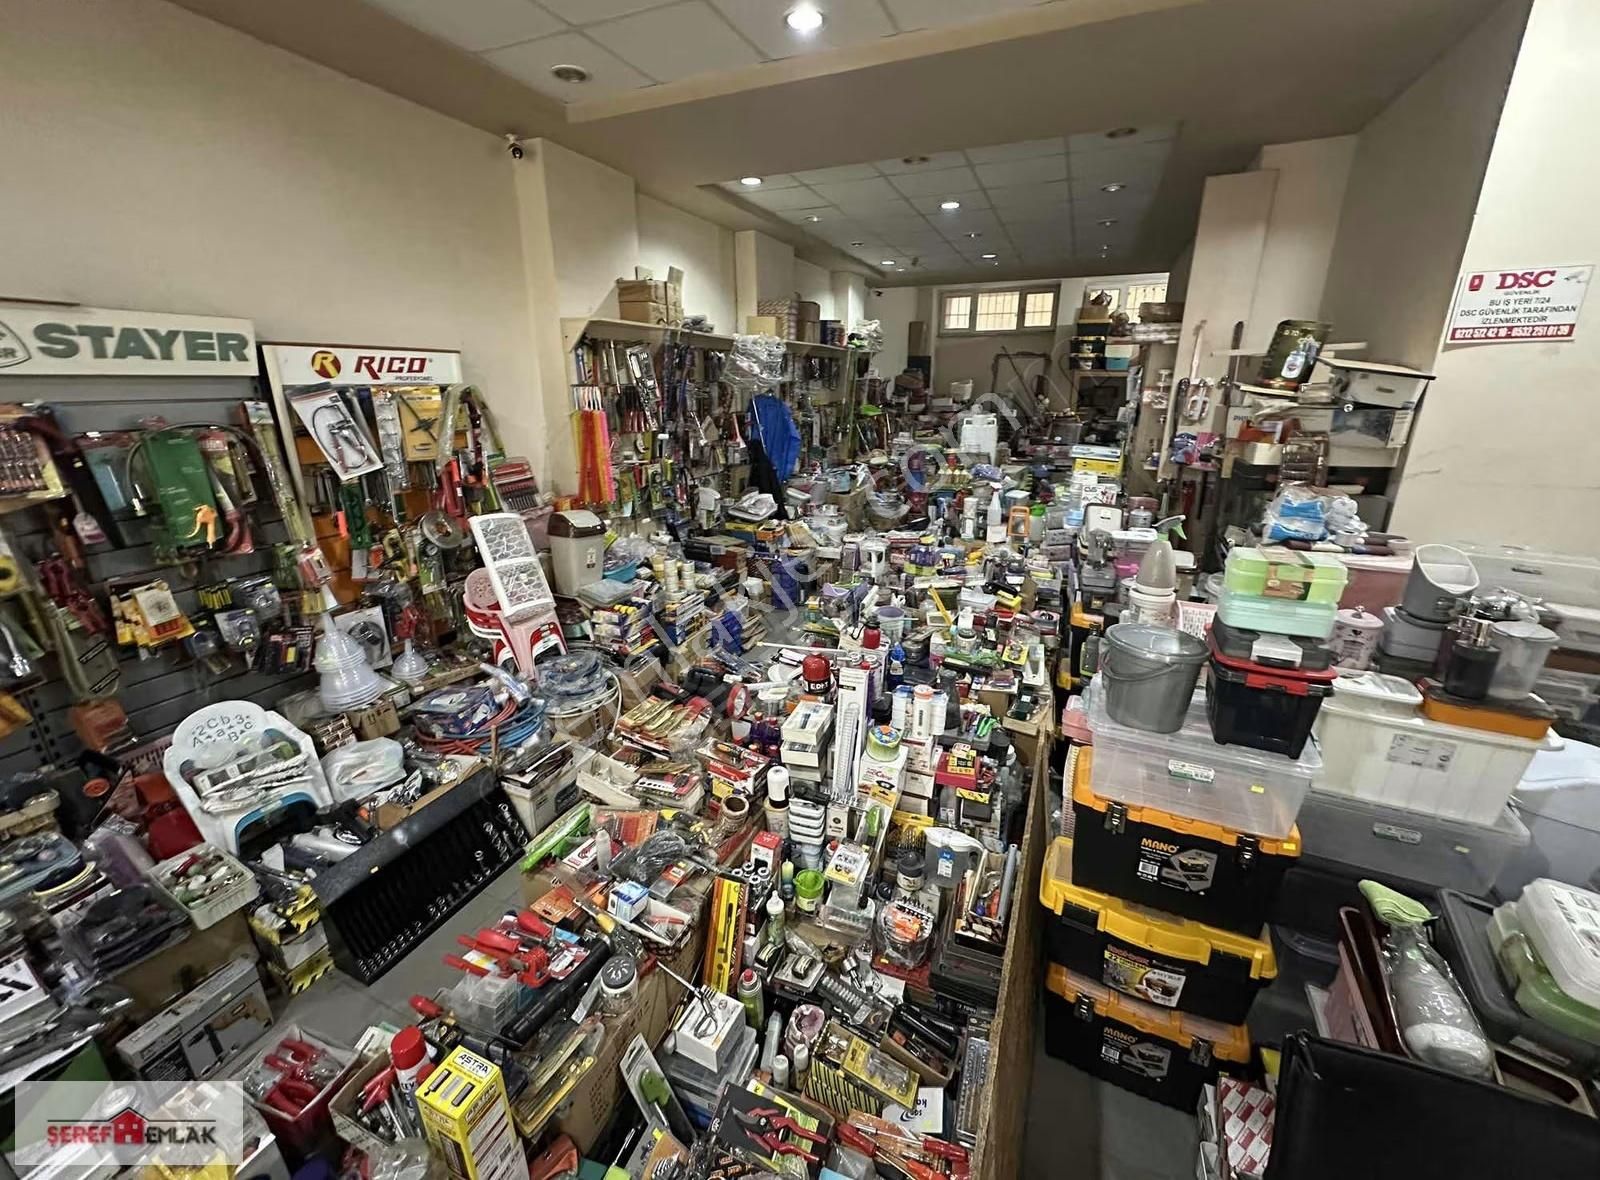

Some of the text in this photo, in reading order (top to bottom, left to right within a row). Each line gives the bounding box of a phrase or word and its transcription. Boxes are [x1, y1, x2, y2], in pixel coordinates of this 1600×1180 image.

[1496, 270, 1556, 290] DSC
[1460, 305, 1577, 317] DSC GÜVENLİK TARAFINDAN
[1489, 298, 1500, 307] BU
[1481, 315, 1548, 325] İZLENMEKTEDİR
[33, 322, 249, 362] STAYER
[355, 355, 428, 380] RICO
[206, 717, 218, 729] C
[221, 715, 231, 725] b
[235, 714, 245, 725] 3
[1140, 837, 1178, 854] MANO
[1103, 1026, 1137, 1044] MANO
[458, 1053, 489, 1074] ASTRA
